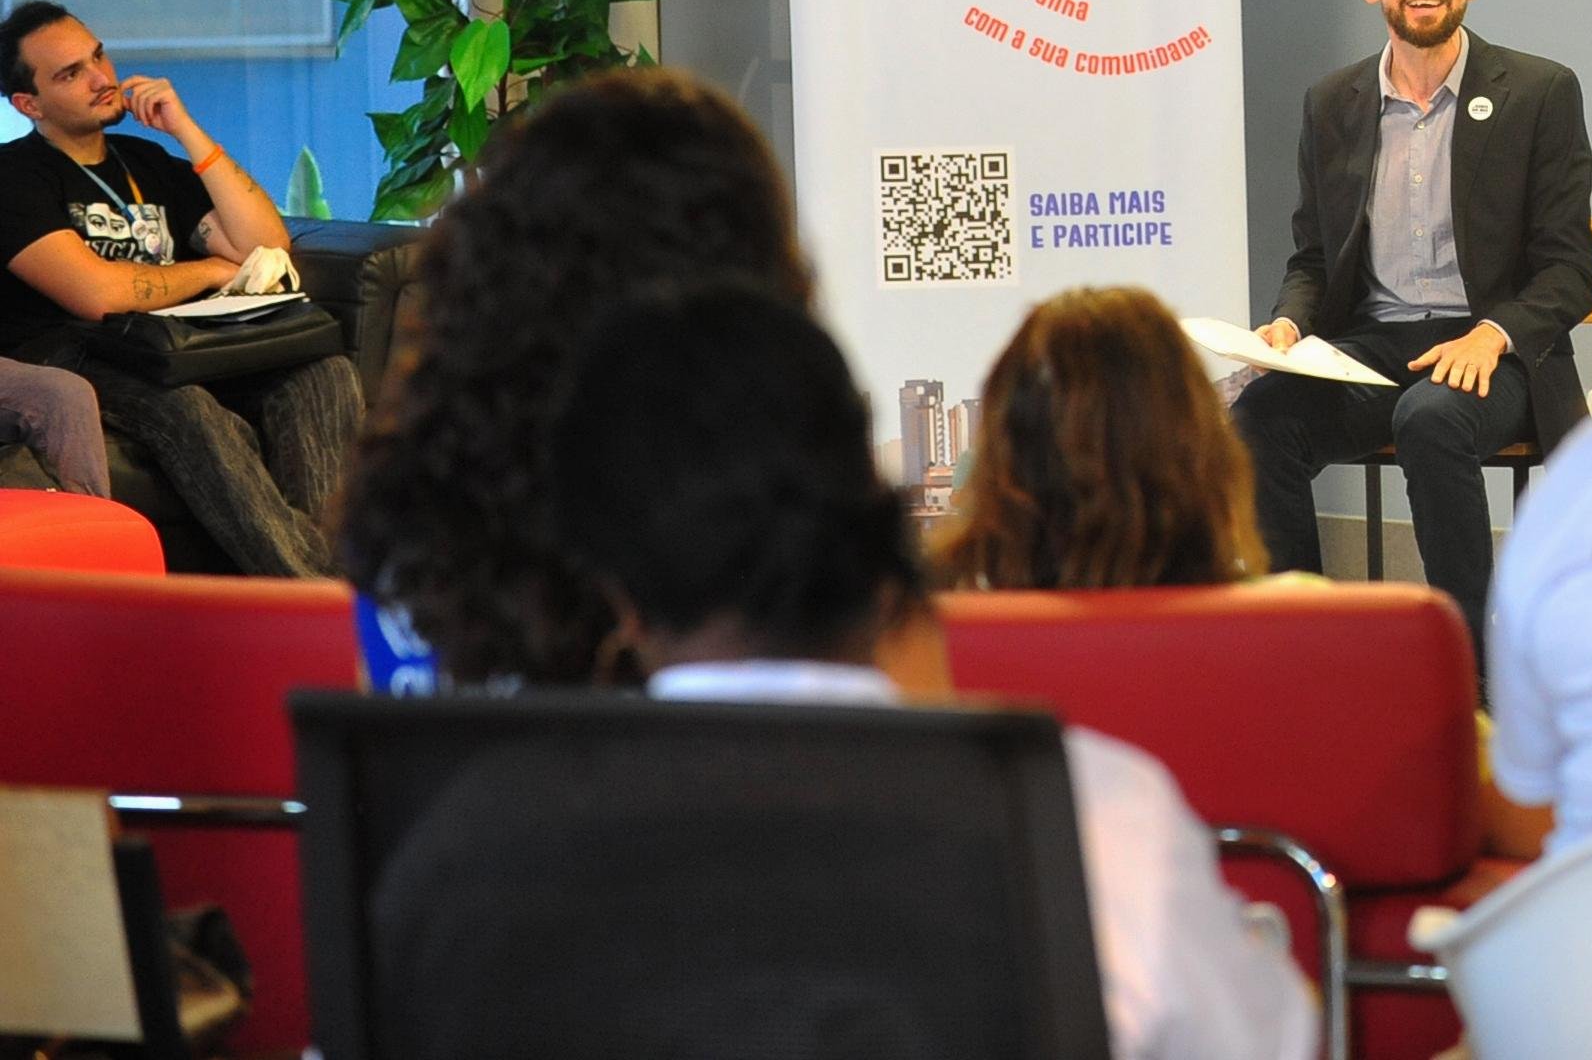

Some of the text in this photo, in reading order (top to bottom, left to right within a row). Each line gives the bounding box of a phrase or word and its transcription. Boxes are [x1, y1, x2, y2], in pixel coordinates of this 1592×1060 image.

[964, 6, 1009, 43] com
[1011, 29, 1026, 50] a
[1028, 37, 1068, 68] sua
[1029, 190, 1165, 216] SAIBA MAIS
[1031, 222, 1172, 248] E PARTICIPE
